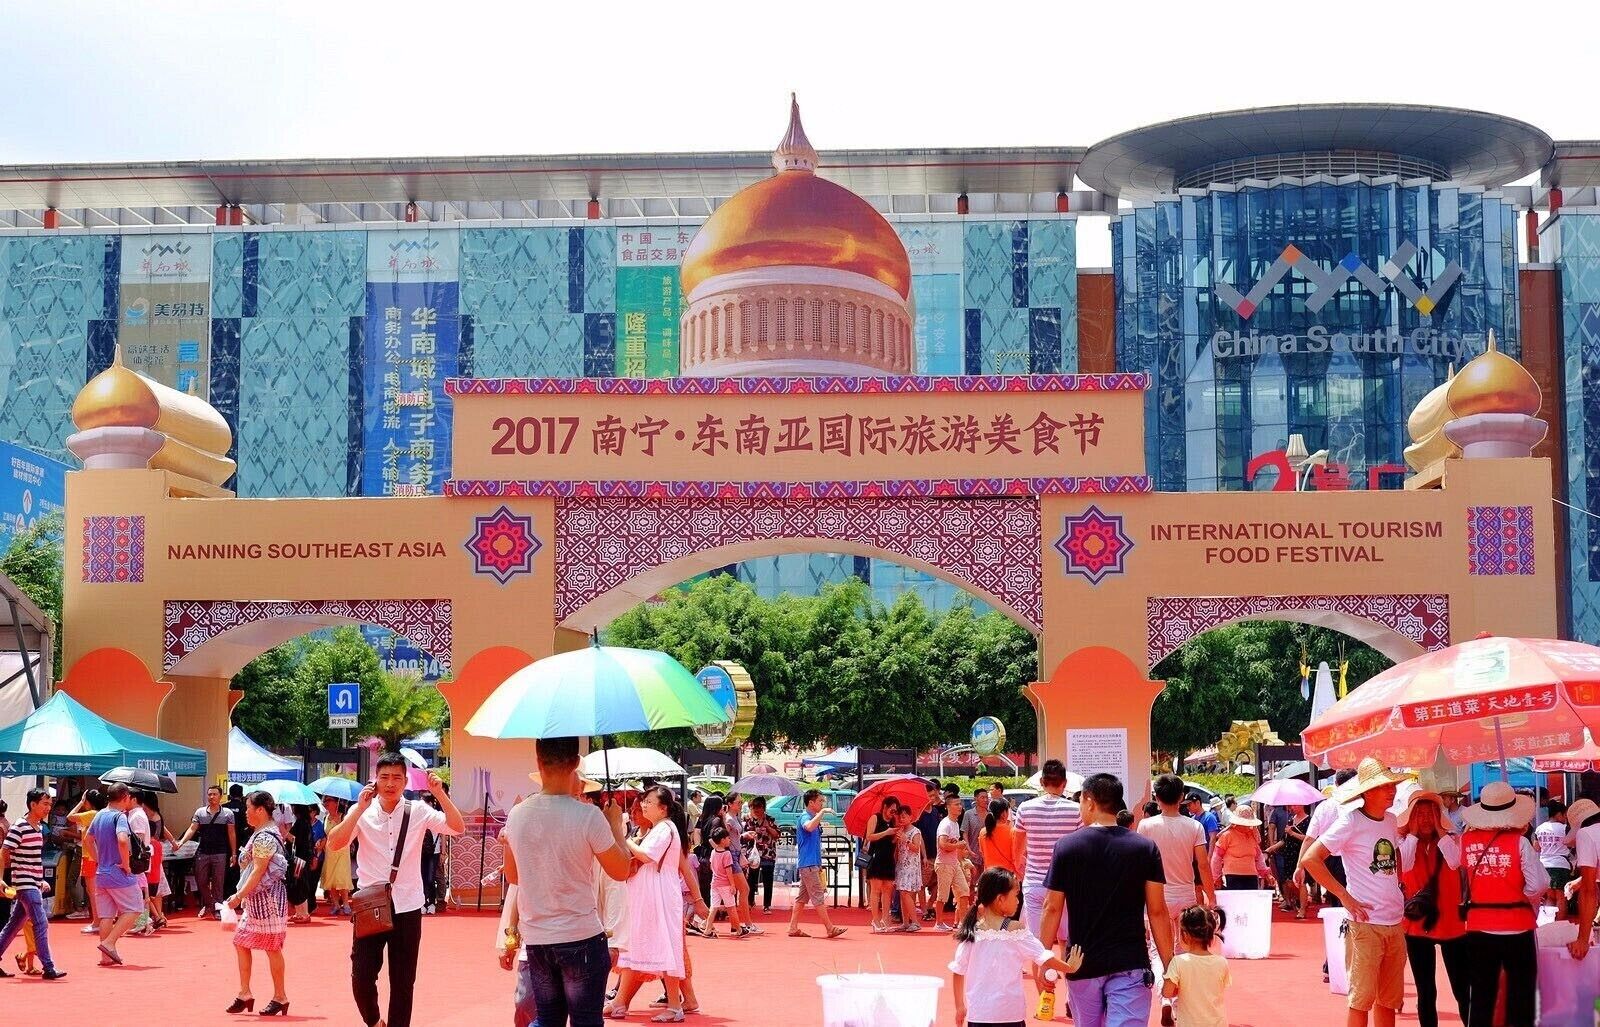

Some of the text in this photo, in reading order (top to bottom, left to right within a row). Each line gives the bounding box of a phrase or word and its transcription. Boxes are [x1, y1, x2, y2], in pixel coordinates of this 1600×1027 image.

[1212, 325, 1468, 364] China South City
[409, 306, 437, 494] 华南城电子商务
[491, 411, 1105, 457] 2017 南宁·东南亚国际旅游美食节
[1150, 521, 1443, 541] INTERNATIONAL TOURISM
[167, 541, 447, 560] NANNING SOUTHEAST ASIA
[1205, 546, 1385, 564] FOOD FESTIVAL
